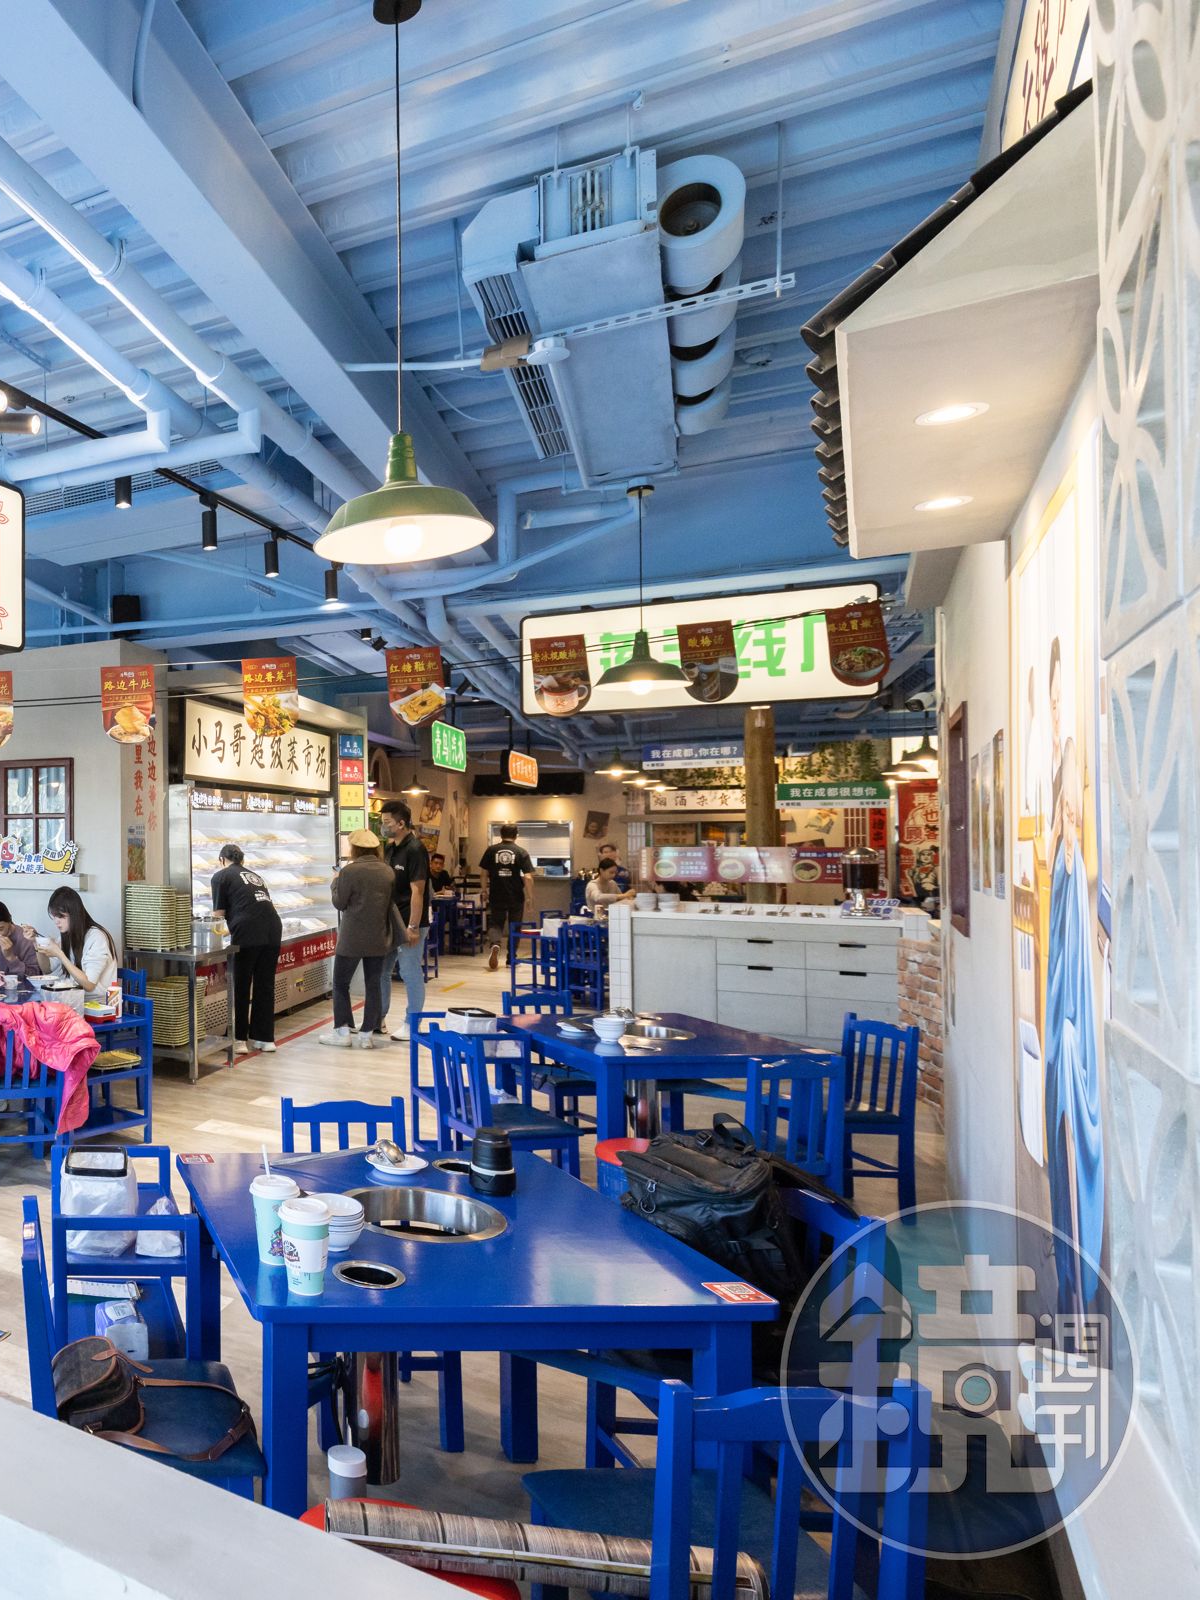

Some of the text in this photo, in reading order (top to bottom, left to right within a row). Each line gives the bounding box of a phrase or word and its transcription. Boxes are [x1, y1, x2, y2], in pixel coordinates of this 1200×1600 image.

[192, 717, 326, 778] 小马哥超级菜市场
